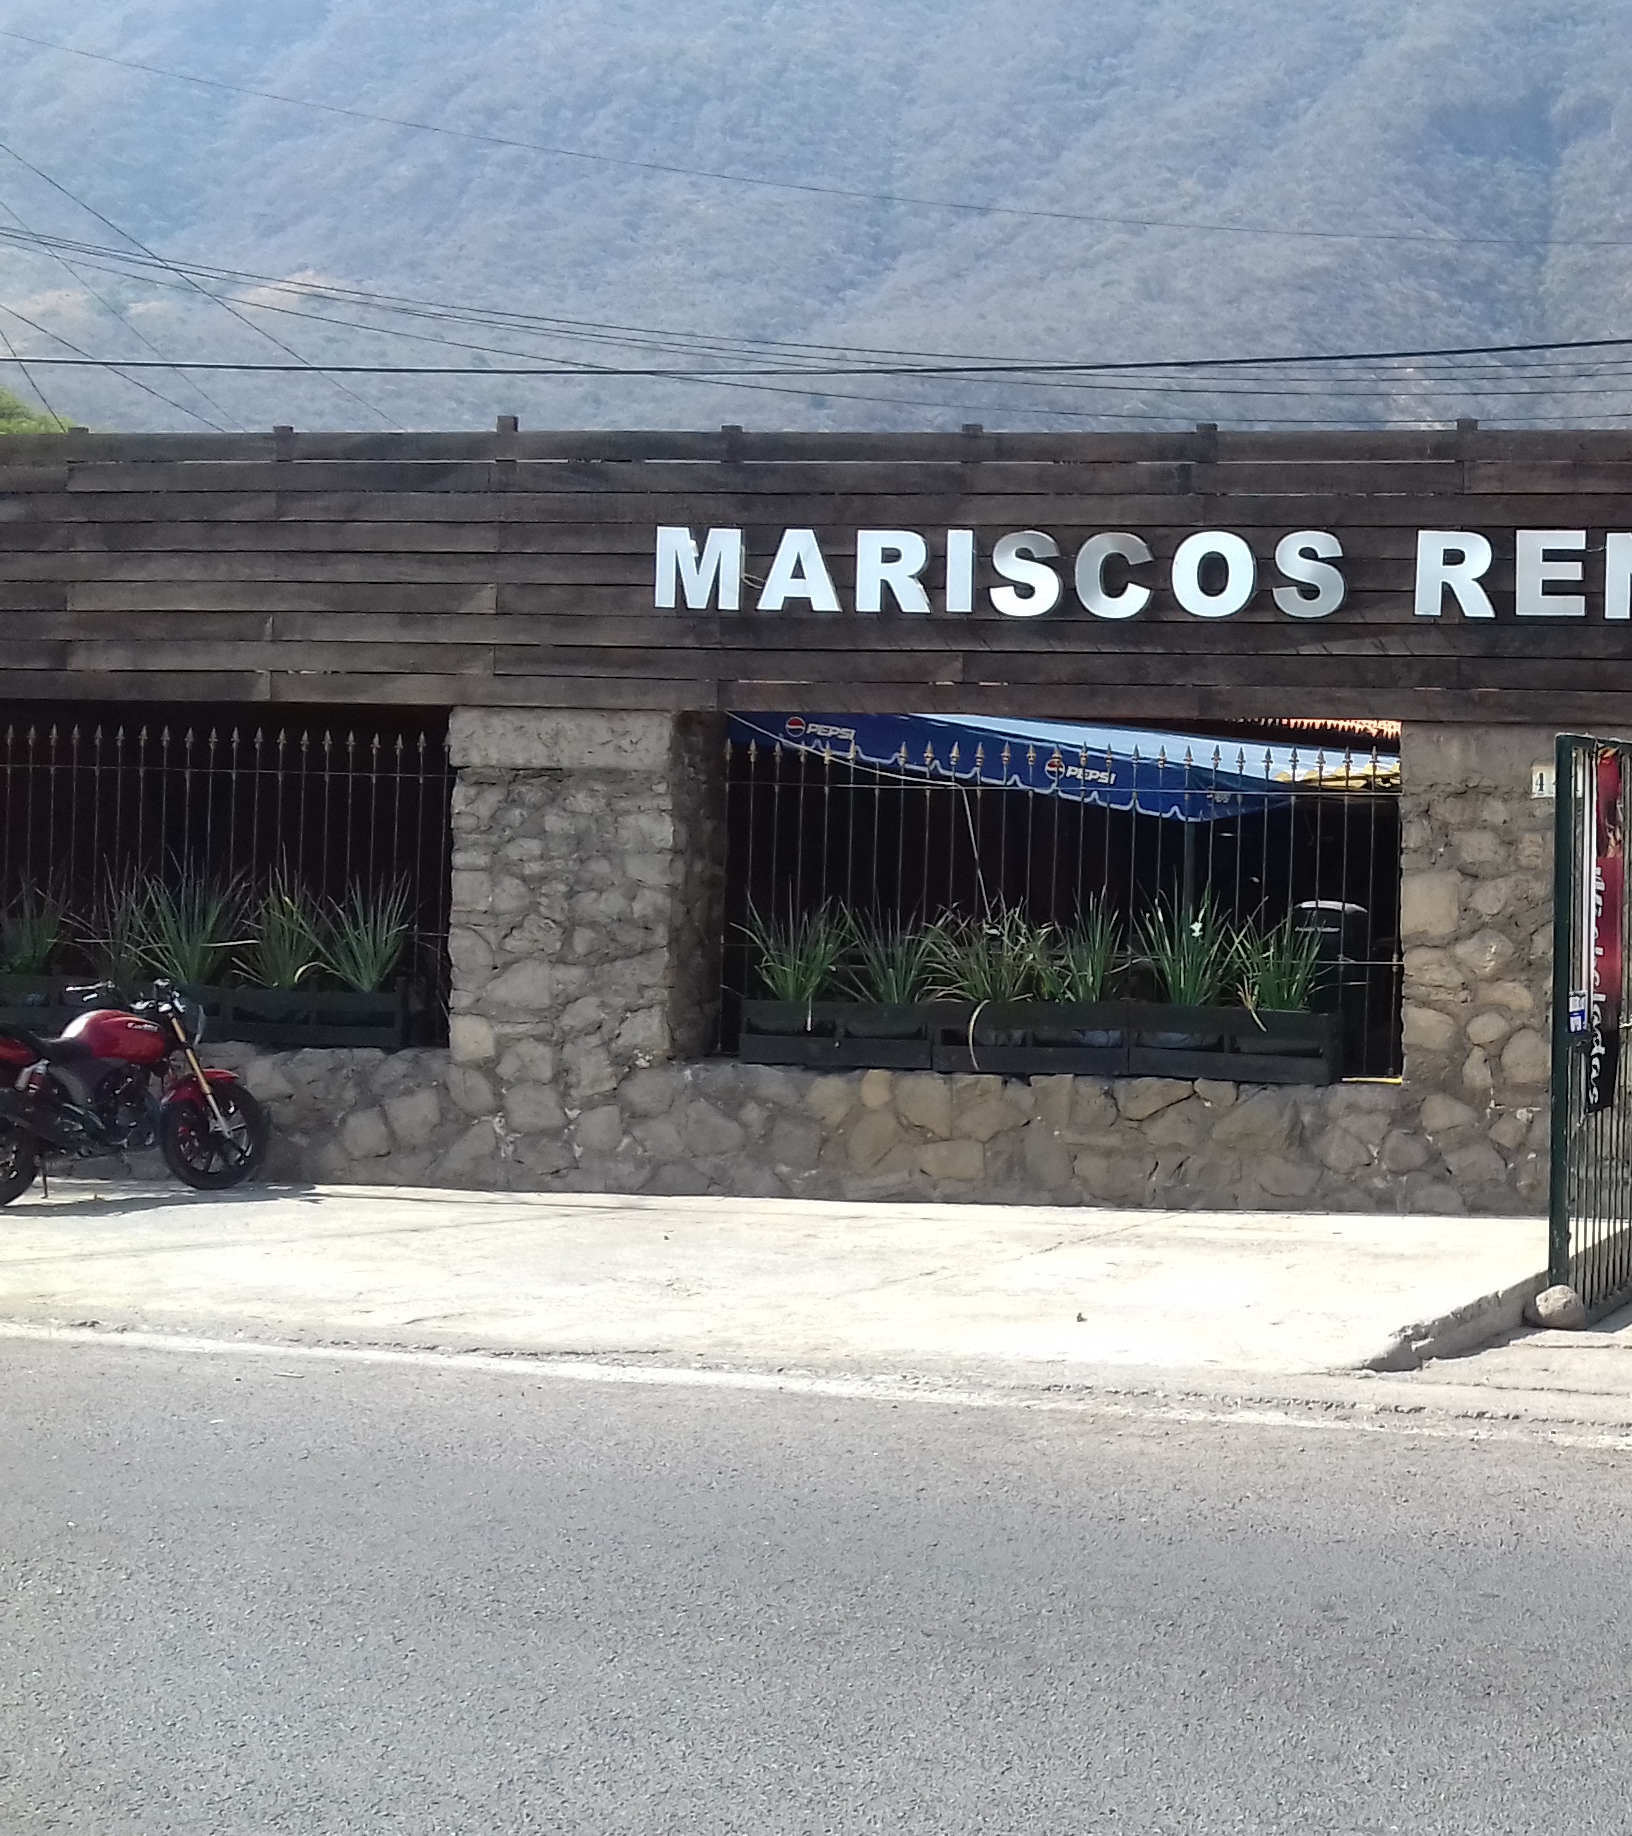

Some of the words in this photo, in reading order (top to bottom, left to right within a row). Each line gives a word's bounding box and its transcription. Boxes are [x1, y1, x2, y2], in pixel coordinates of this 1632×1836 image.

[654, 525, 1345, 619] MARISCOS
[806, 723, 856, 741] PEPSI
[1066, 766, 1117, 785] PEPSI
